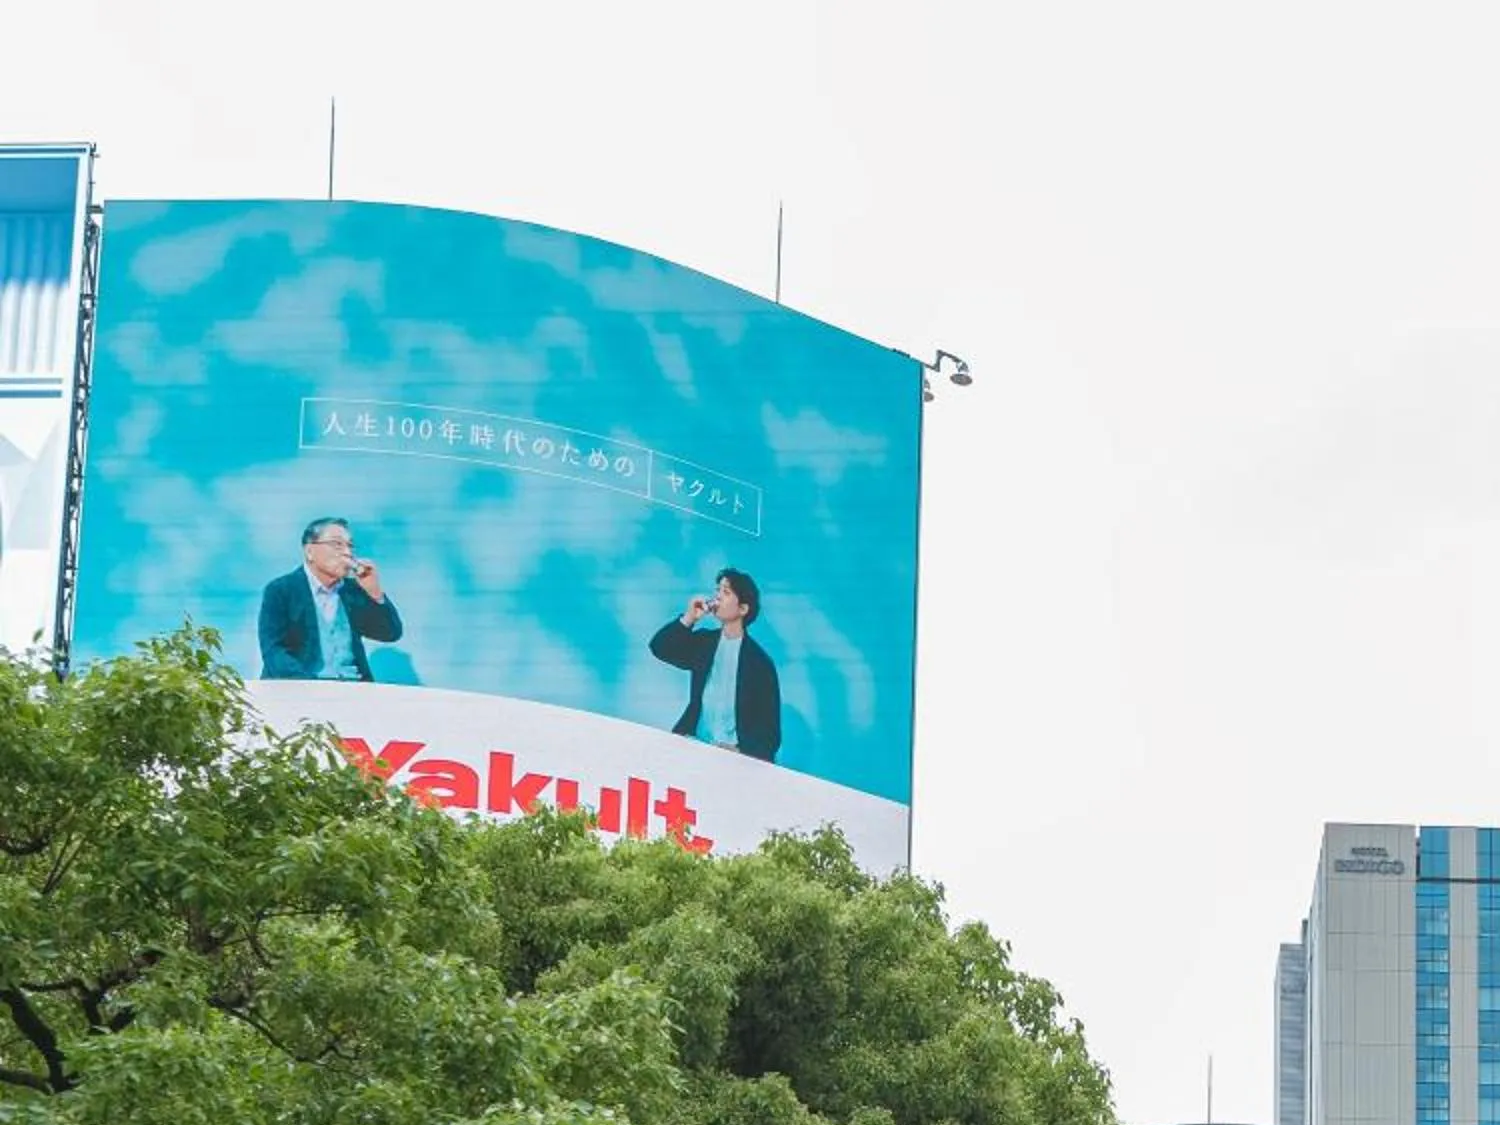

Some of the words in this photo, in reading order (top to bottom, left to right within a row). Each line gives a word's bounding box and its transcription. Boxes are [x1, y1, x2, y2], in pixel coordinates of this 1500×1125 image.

[321, 411, 636, 479] 人生100年時代のための
[666, 471, 746, 515] ヤクルト
[337, 737, 714, 855] Yakult
